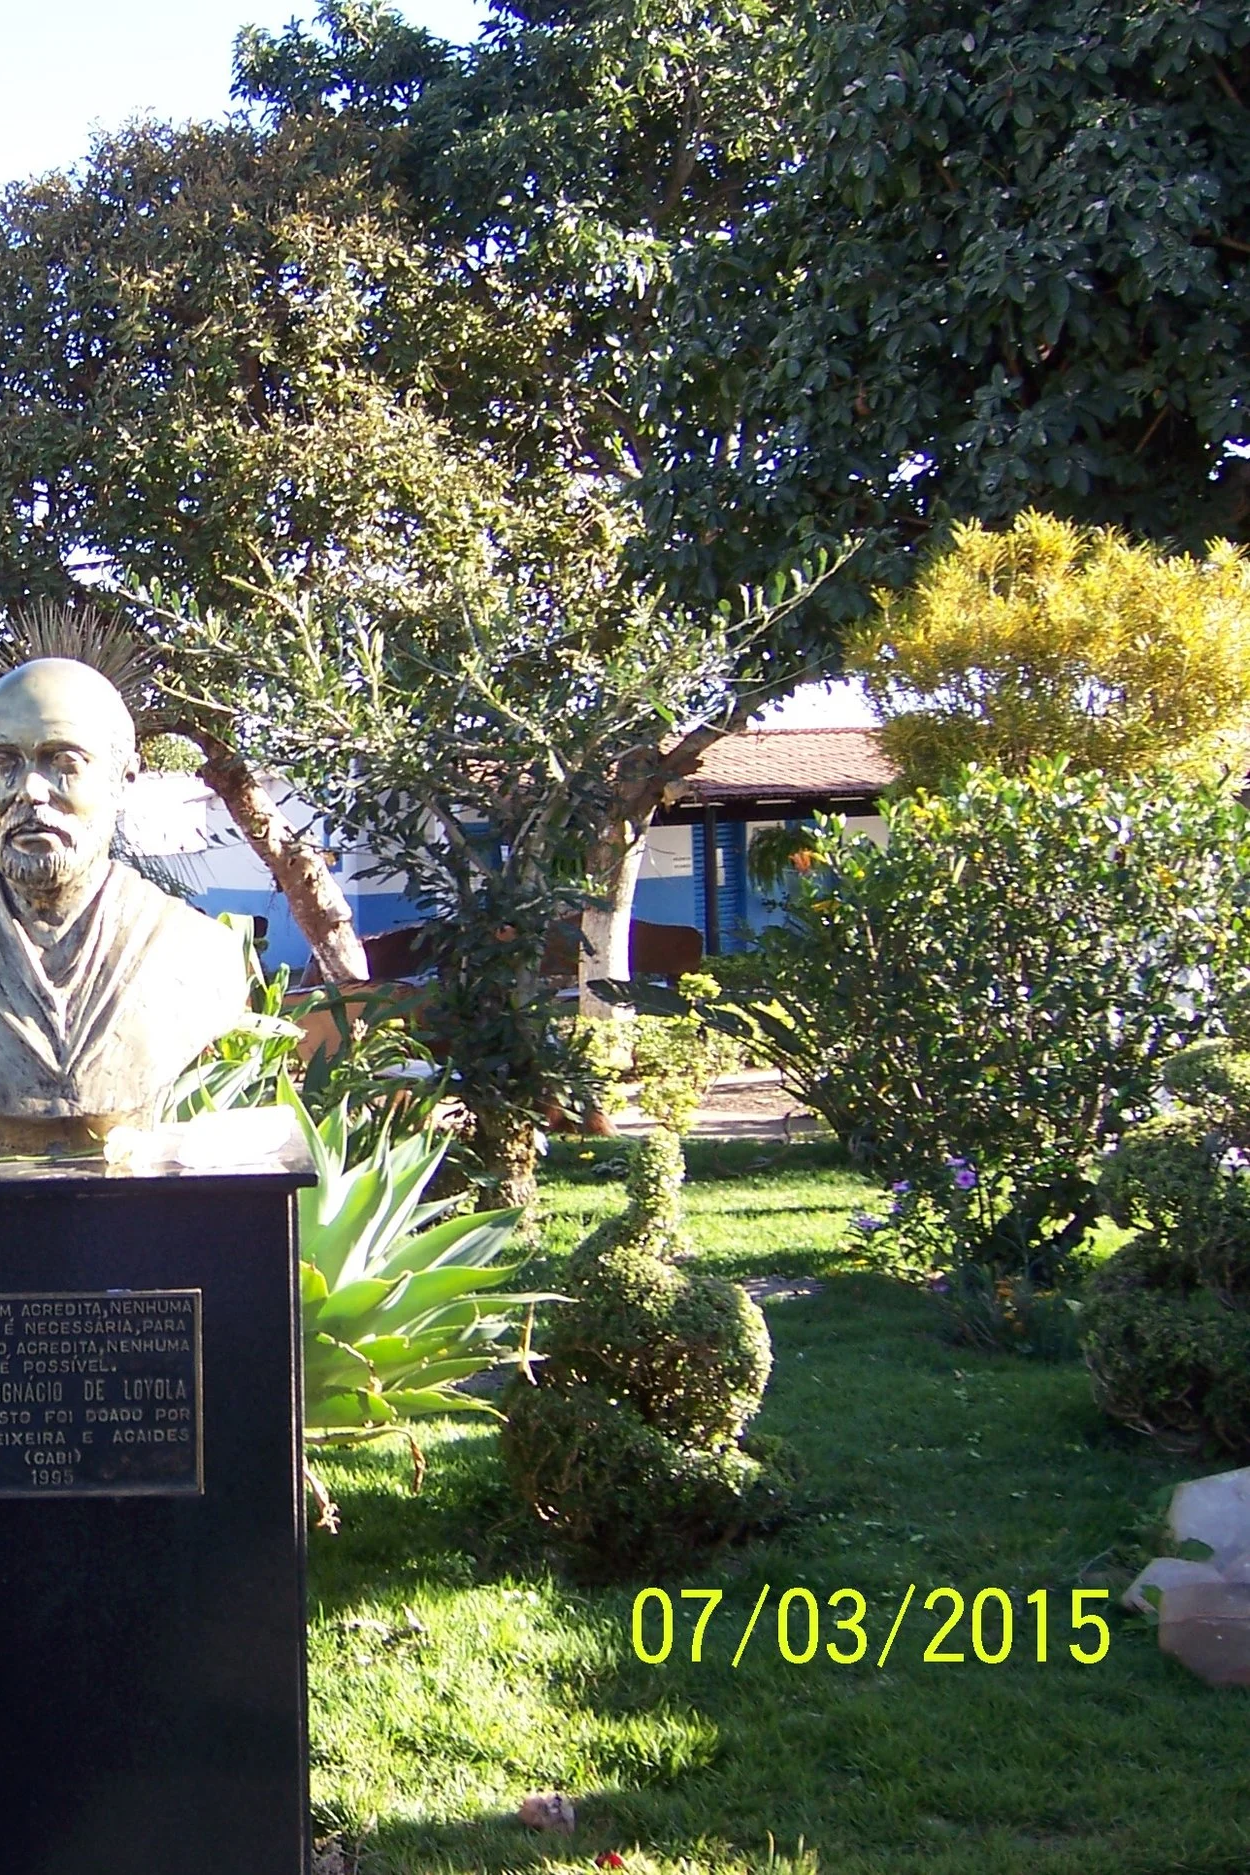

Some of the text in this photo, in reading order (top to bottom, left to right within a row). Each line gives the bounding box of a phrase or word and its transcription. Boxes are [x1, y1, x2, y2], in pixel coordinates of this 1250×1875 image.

[4, 1317, 14, 1335] É
[0, 1354, 10, 1374] É
[23, 1355, 117, 1374] POSSÍVEL.
[84, 1379, 106, 1401] DE
[124, 1378, 186, 1400] LOYOLA
[45, 1410, 73, 1423] FOI
[85, 1408, 143, 1423] DOADO
[155, 1408, 190, 1421] POR
[82, 1431, 93, 1444] E
[32, 1469, 74, 1485] 1995
